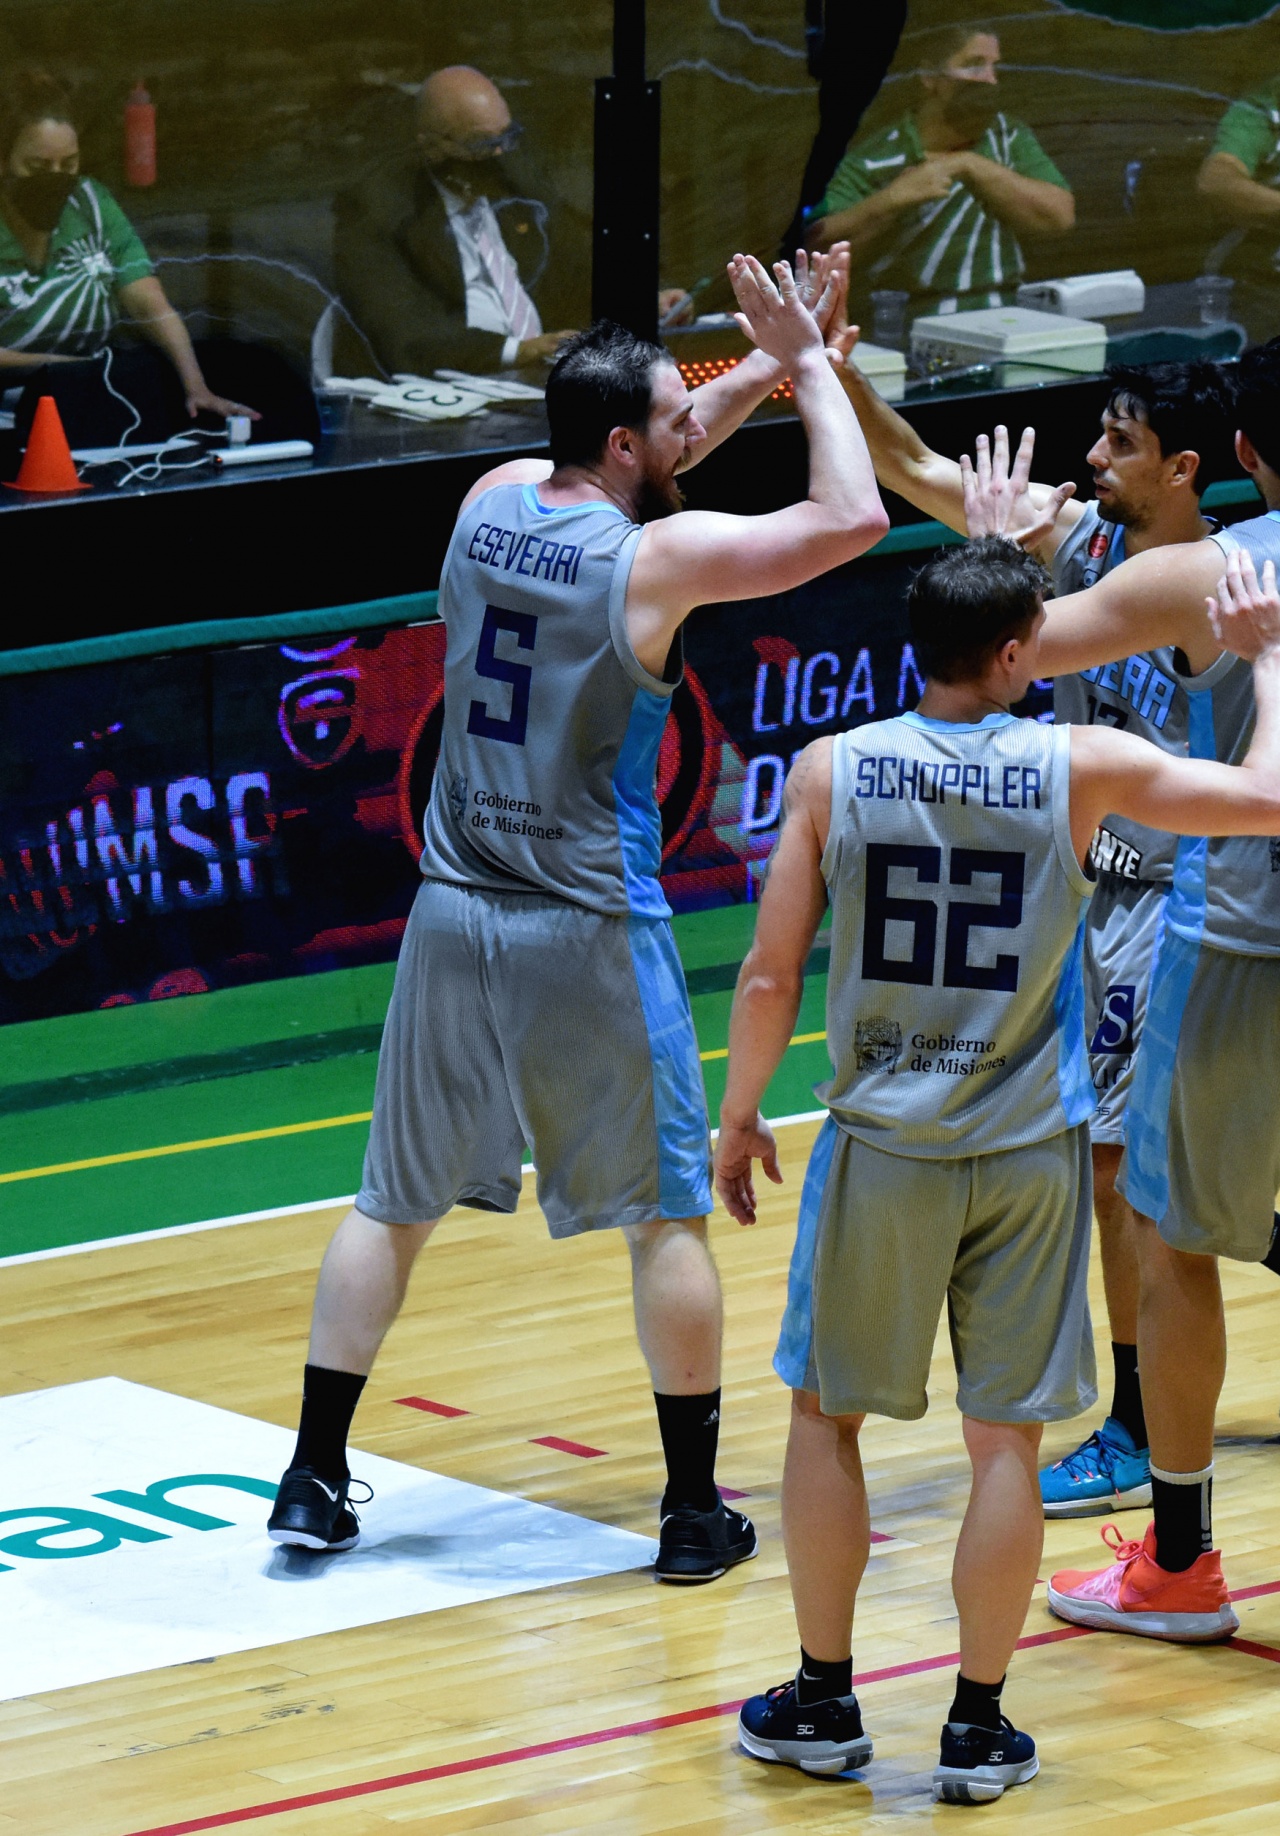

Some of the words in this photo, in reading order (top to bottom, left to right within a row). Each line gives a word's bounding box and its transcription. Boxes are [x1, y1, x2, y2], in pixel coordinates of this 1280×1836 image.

[468, 522, 584, 585] ESEVERRI
[467, 604, 538, 746] 5
[752, 648, 876, 733] LIGA
[473, 790, 541, 816] Gobierno
[855, 756, 1041, 810] SCHOPPLER
[471, 811, 490, 829] de
[492, 814, 563, 840] Misiones
[861, 842, 1026, 992] 62
[910, 1055, 932, 1073] de
[935, 1054, 1006, 1076] Misiones
[911, 1034, 996, 1053] Gobierno
[0, 1473, 280, 1573] an
